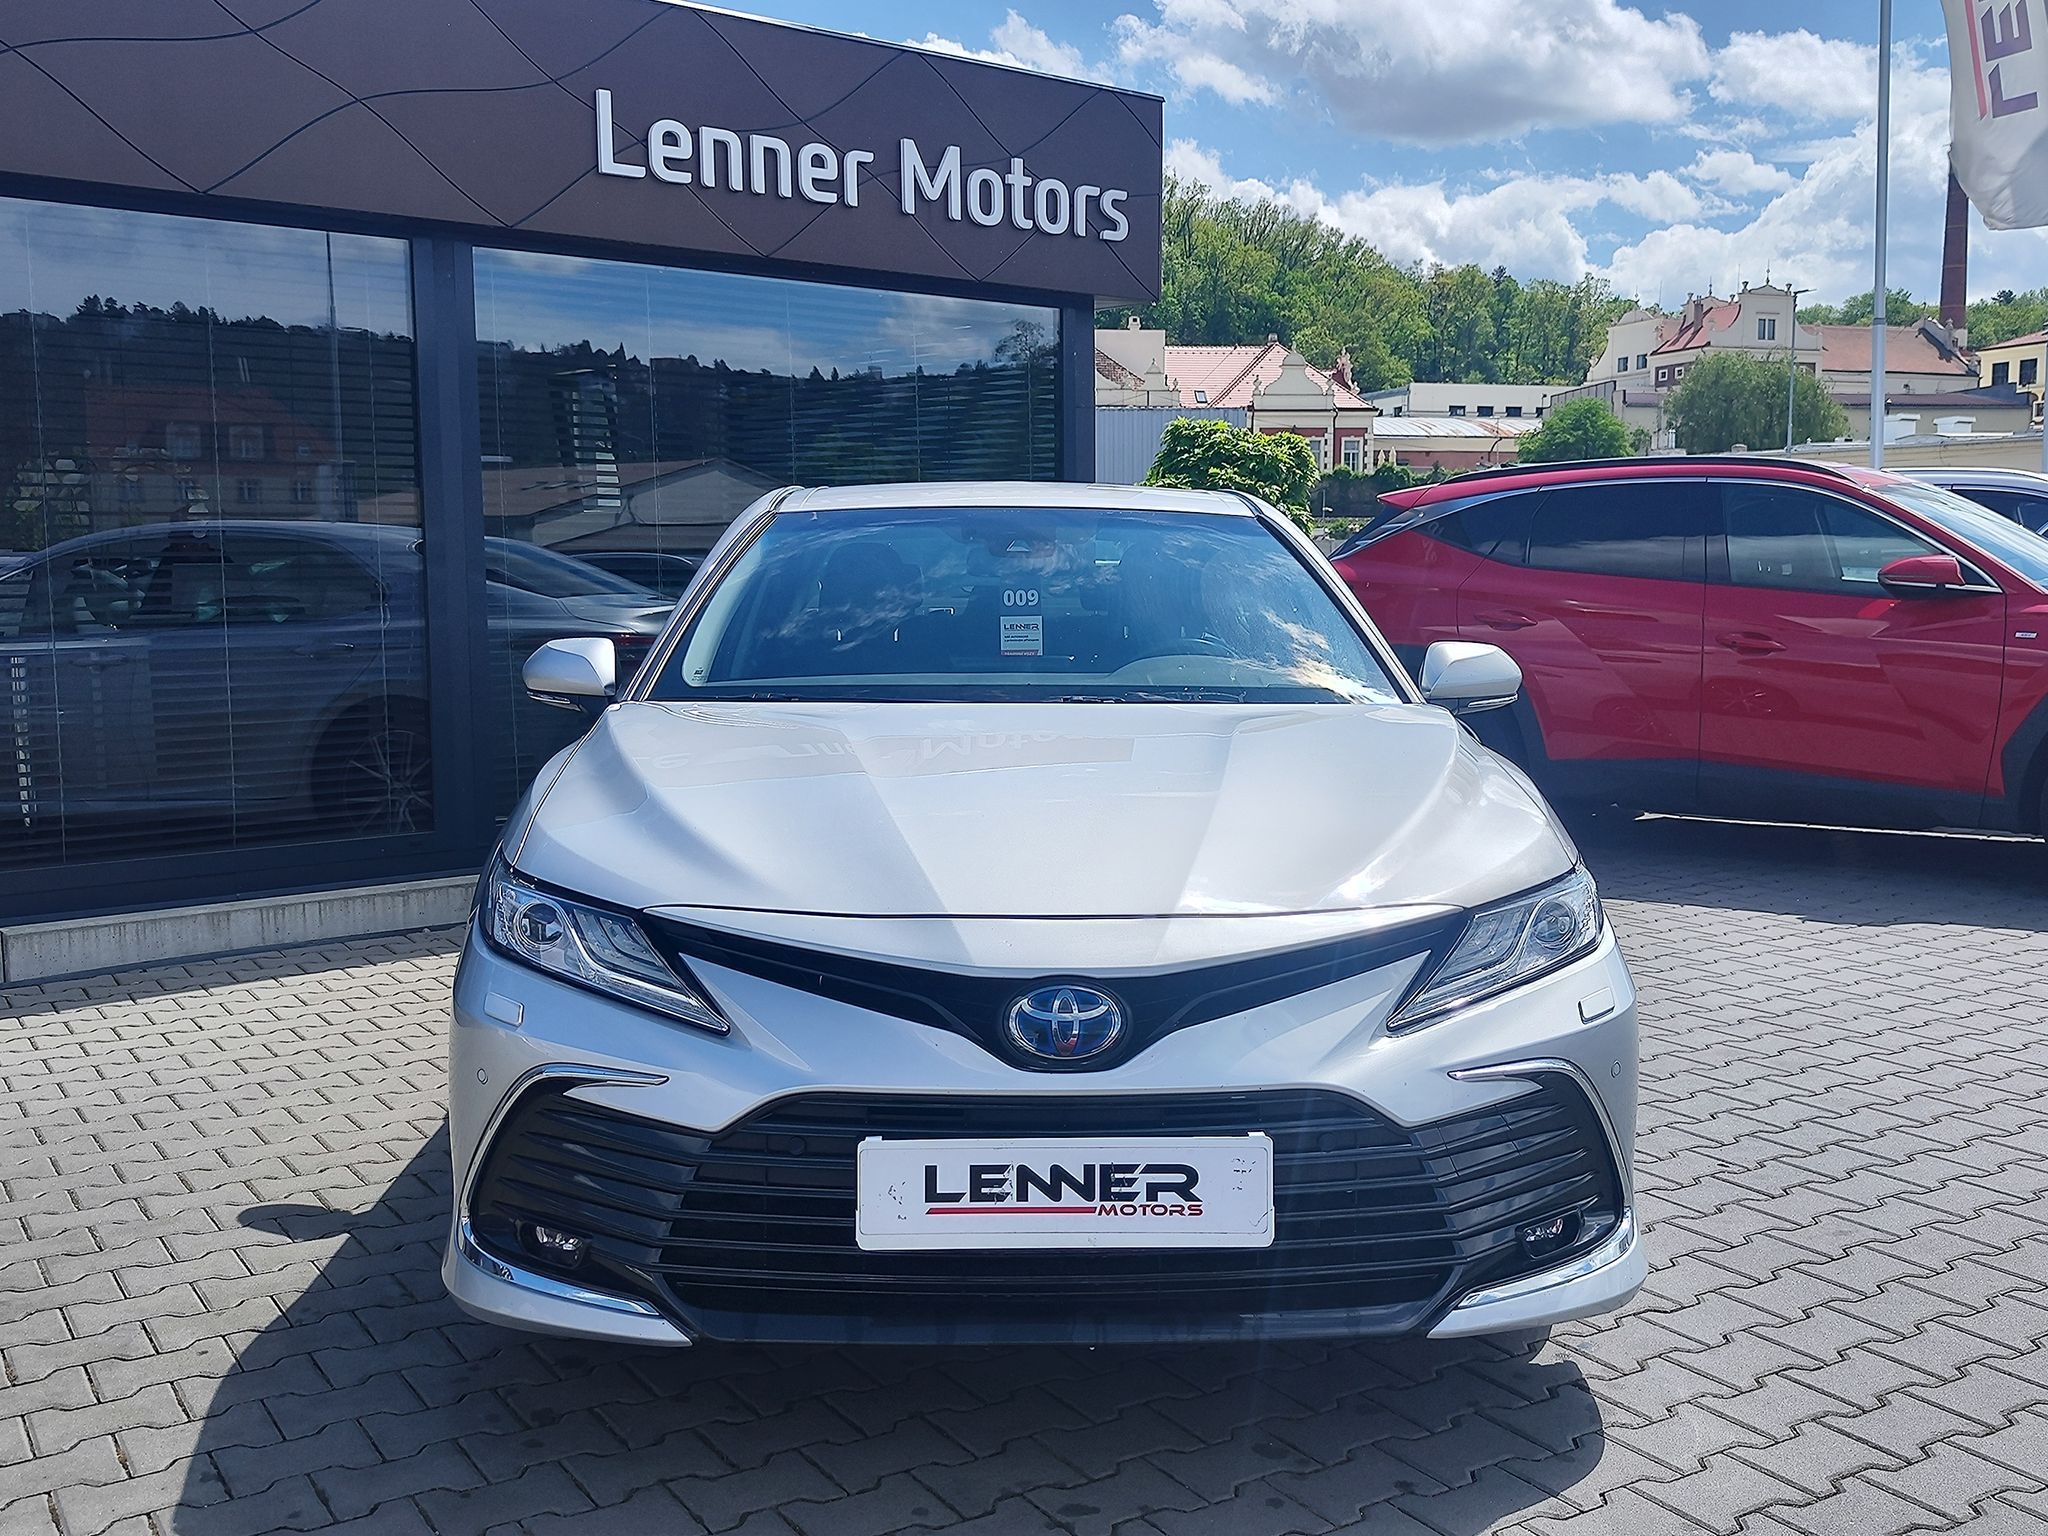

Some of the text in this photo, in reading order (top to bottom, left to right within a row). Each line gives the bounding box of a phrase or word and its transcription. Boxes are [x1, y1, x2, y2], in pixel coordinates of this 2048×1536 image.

[595, 88, 1129, 242] Lenner Motors
[1003, 589, 1039, 607] 009
[924, 1163, 1202, 1203] LENNER
[1097, 1204, 1204, 1217] MOTORS
